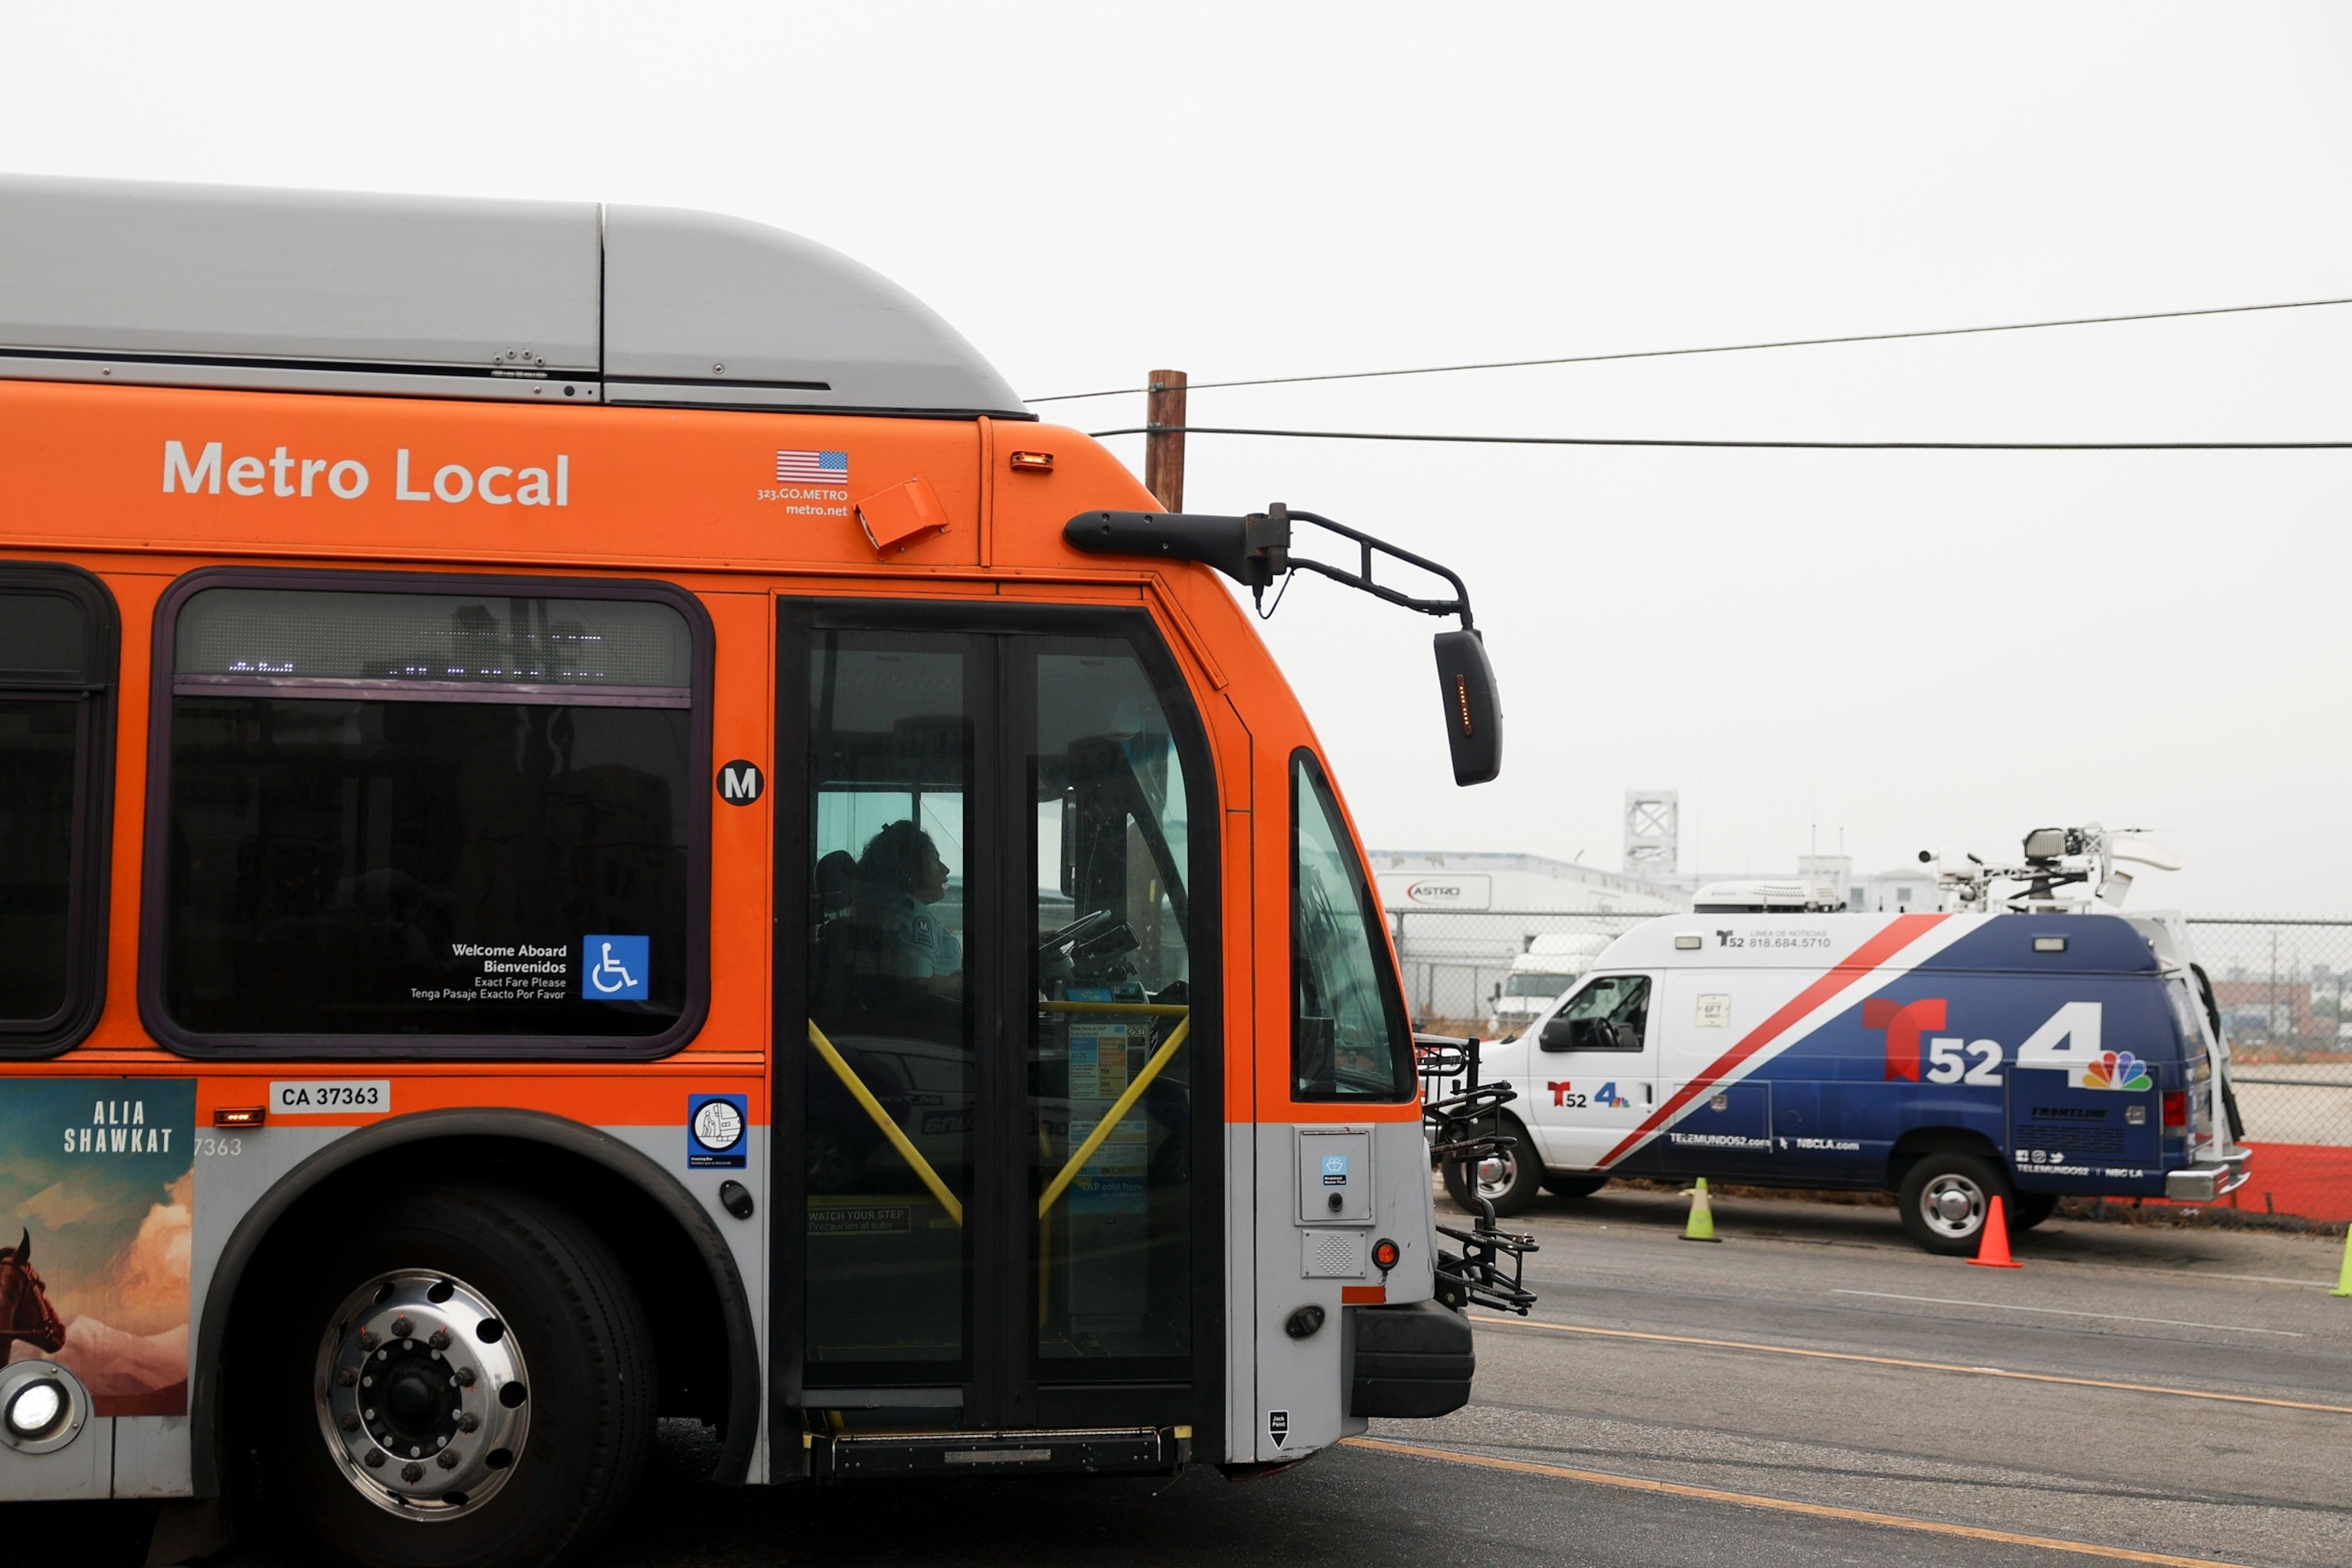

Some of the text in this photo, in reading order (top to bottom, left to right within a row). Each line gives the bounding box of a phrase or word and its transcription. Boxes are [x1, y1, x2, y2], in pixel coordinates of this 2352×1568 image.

[162, 439, 570, 506] Metro Local
[756, 488, 848, 501] 323.GO.METRO
[786, 503, 848, 518] metro.net
[724, 767, 756, 799] M
[1413, 887, 1461, 896] ASTRO
[1729, 938, 1745, 948] 52
[1749, 938, 1831, 948] 818.684.5710
[452, 943, 567, 958] Welcome Aboard
[484, 961, 567, 973] Bienvenidos
[474, 977, 567, 988] Exact Fare Please
[410, 988, 566, 1001] Tenga Pasaje Exacto Por Favor
[2016, 1001, 2102, 1089] 4
[1926, 1037, 2004, 1086] 52
[282, 1086, 380, 1106] CA 37363
[1566, 1094, 1587, 1108] 52
[1594, 1082, 1619, 1108] 4
[93, 1100, 145, 1125] ALIA
[2031, 1106, 2109, 1119] FRONTLINE
[64, 1129, 172, 1153] SHAWKAT
[194, 1138, 242, 1156] 7363
[1669, 1132, 1860, 1152] TELEMUNDO52.com NBCLA.com
[2104, 1168, 2127, 1178] NBC
[2128, 1169, 2144, 1179] LA
[808, 1210, 904, 1221] WATCH YOUR STEP
[808, 1220, 893, 1231] Precaución al subir
